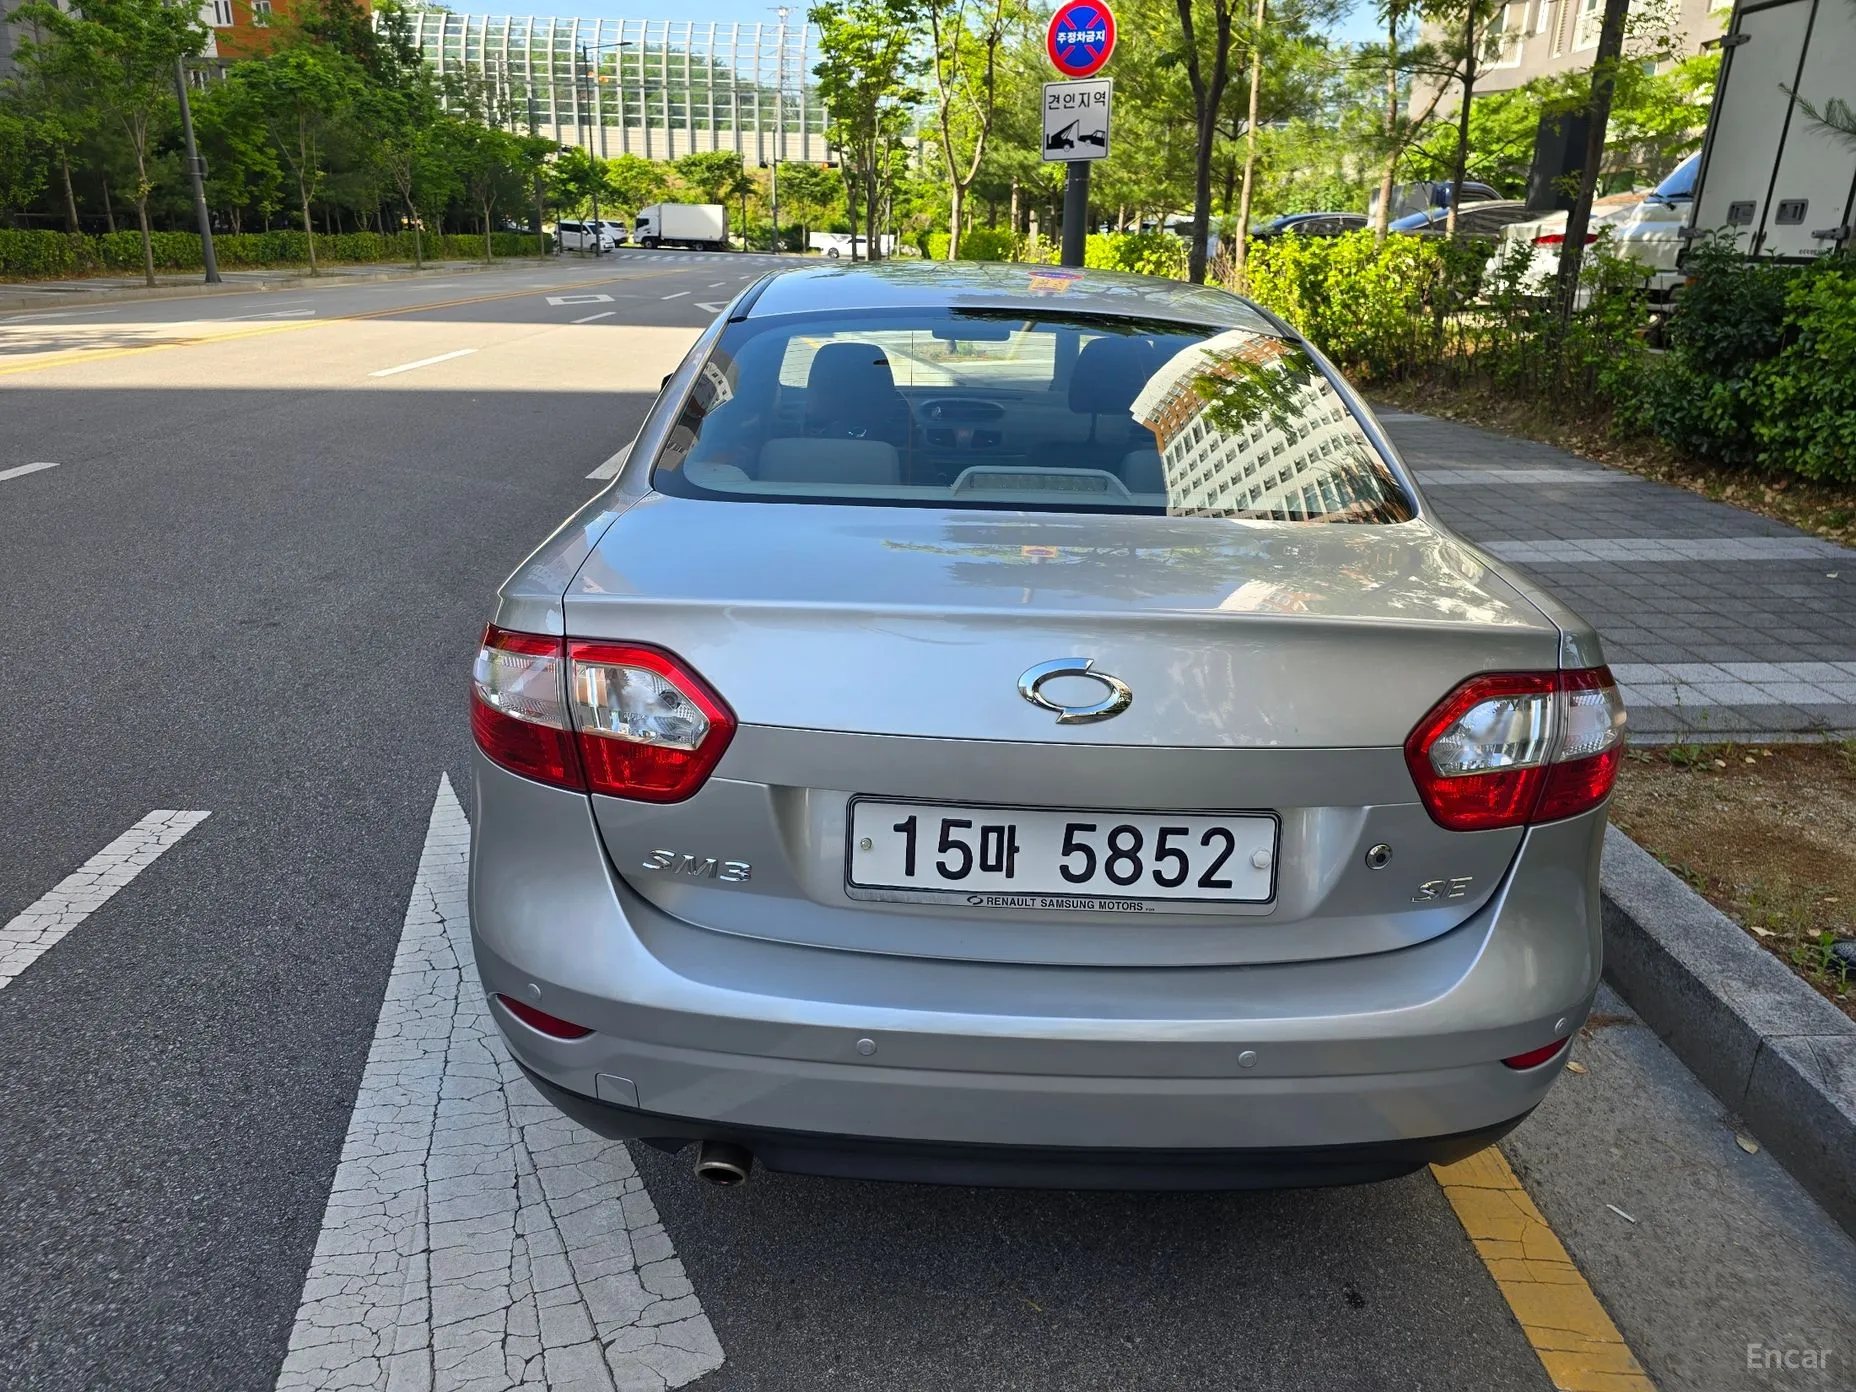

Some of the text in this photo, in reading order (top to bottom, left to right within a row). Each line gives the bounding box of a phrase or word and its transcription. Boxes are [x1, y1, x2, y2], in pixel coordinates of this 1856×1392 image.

[1056, 29, 1105, 44] 주정차금지
[1048, 91, 1106, 110] 견인지역
[893, 814, 1236, 889] 15마 5852
[641, 848, 752, 882] SM3
[1409, 876, 1473, 903] SE
[986, 896, 1037, 907] RENAULT
[1040, 898, 1095, 910] SAMSUNG
[1098, 901, 1144, 912] MOTORS
